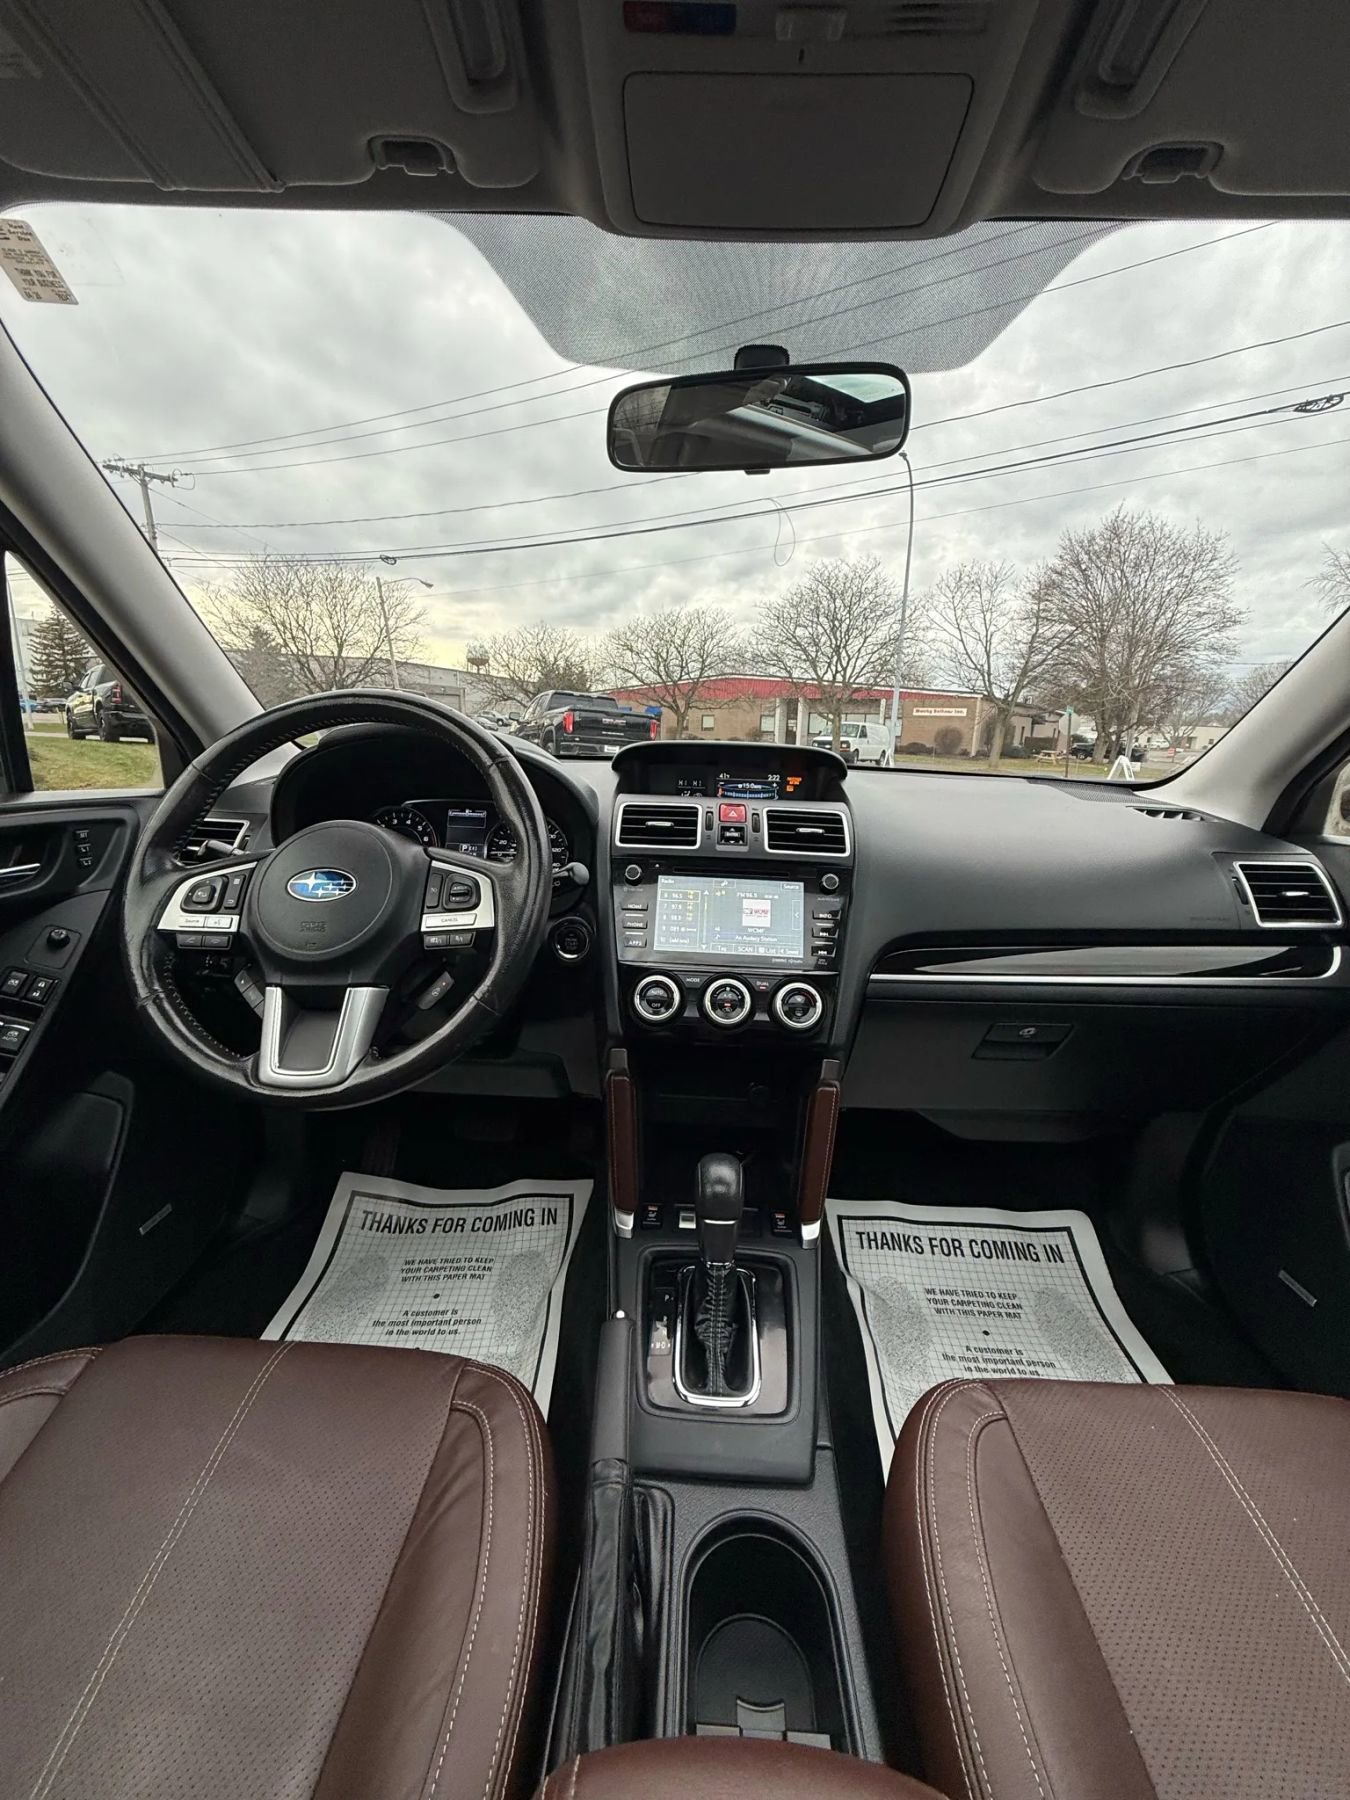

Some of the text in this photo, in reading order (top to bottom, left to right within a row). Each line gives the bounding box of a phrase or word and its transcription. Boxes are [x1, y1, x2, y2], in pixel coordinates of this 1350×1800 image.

[360, 1208, 558, 1235] THANKS FOR COMING IN
[856, 1231, 1064, 1264] THANKS FOR COMING IN
[925, 1288, 937, 1296] WE
[939, 1289, 960, 1297] HAVE
[962, 1290, 984, 1298] TRIED
[951, 1299, 995, 1309] CARPETING
[997, 1302, 1022, 1310] CLEAN
[978, 1310, 1003, 1318] PAPER
[411, 1318, 451, 1328] important
[453, 1318, 481, 1326] person
[974, 1347, 1014, 1355] customer
[942, 1354, 1056, 1369] the most important person
[992, 1366, 1016, 1375] world
